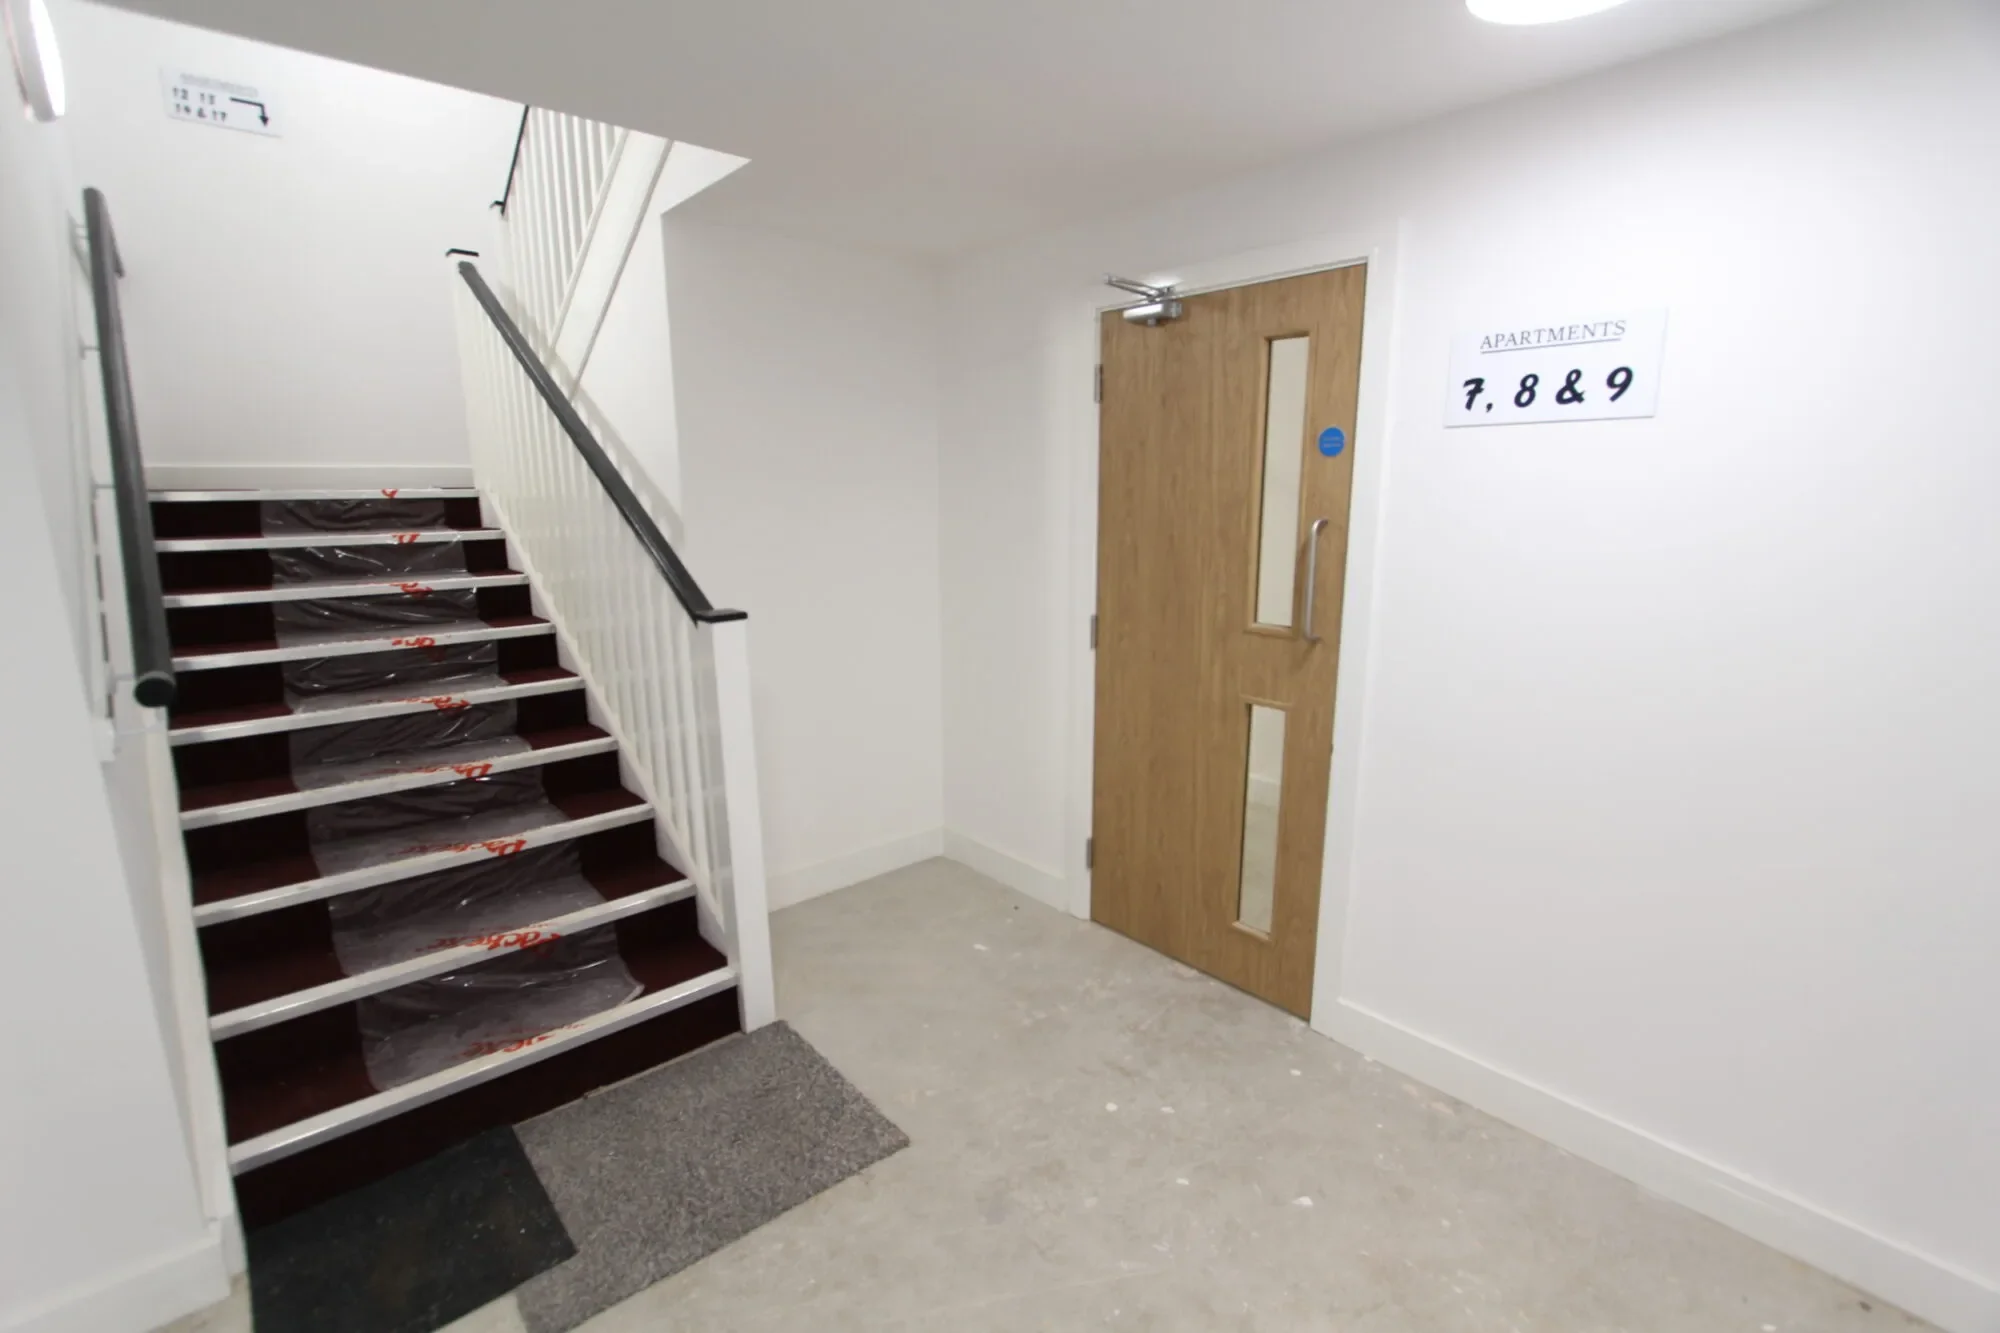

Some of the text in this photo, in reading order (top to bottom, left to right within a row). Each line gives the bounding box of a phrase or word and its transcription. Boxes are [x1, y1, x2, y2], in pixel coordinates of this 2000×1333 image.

[1480, 319, 1626, 350] APARTMENTS
[1463, 366, 1633, 412] 7, 8 & 9
